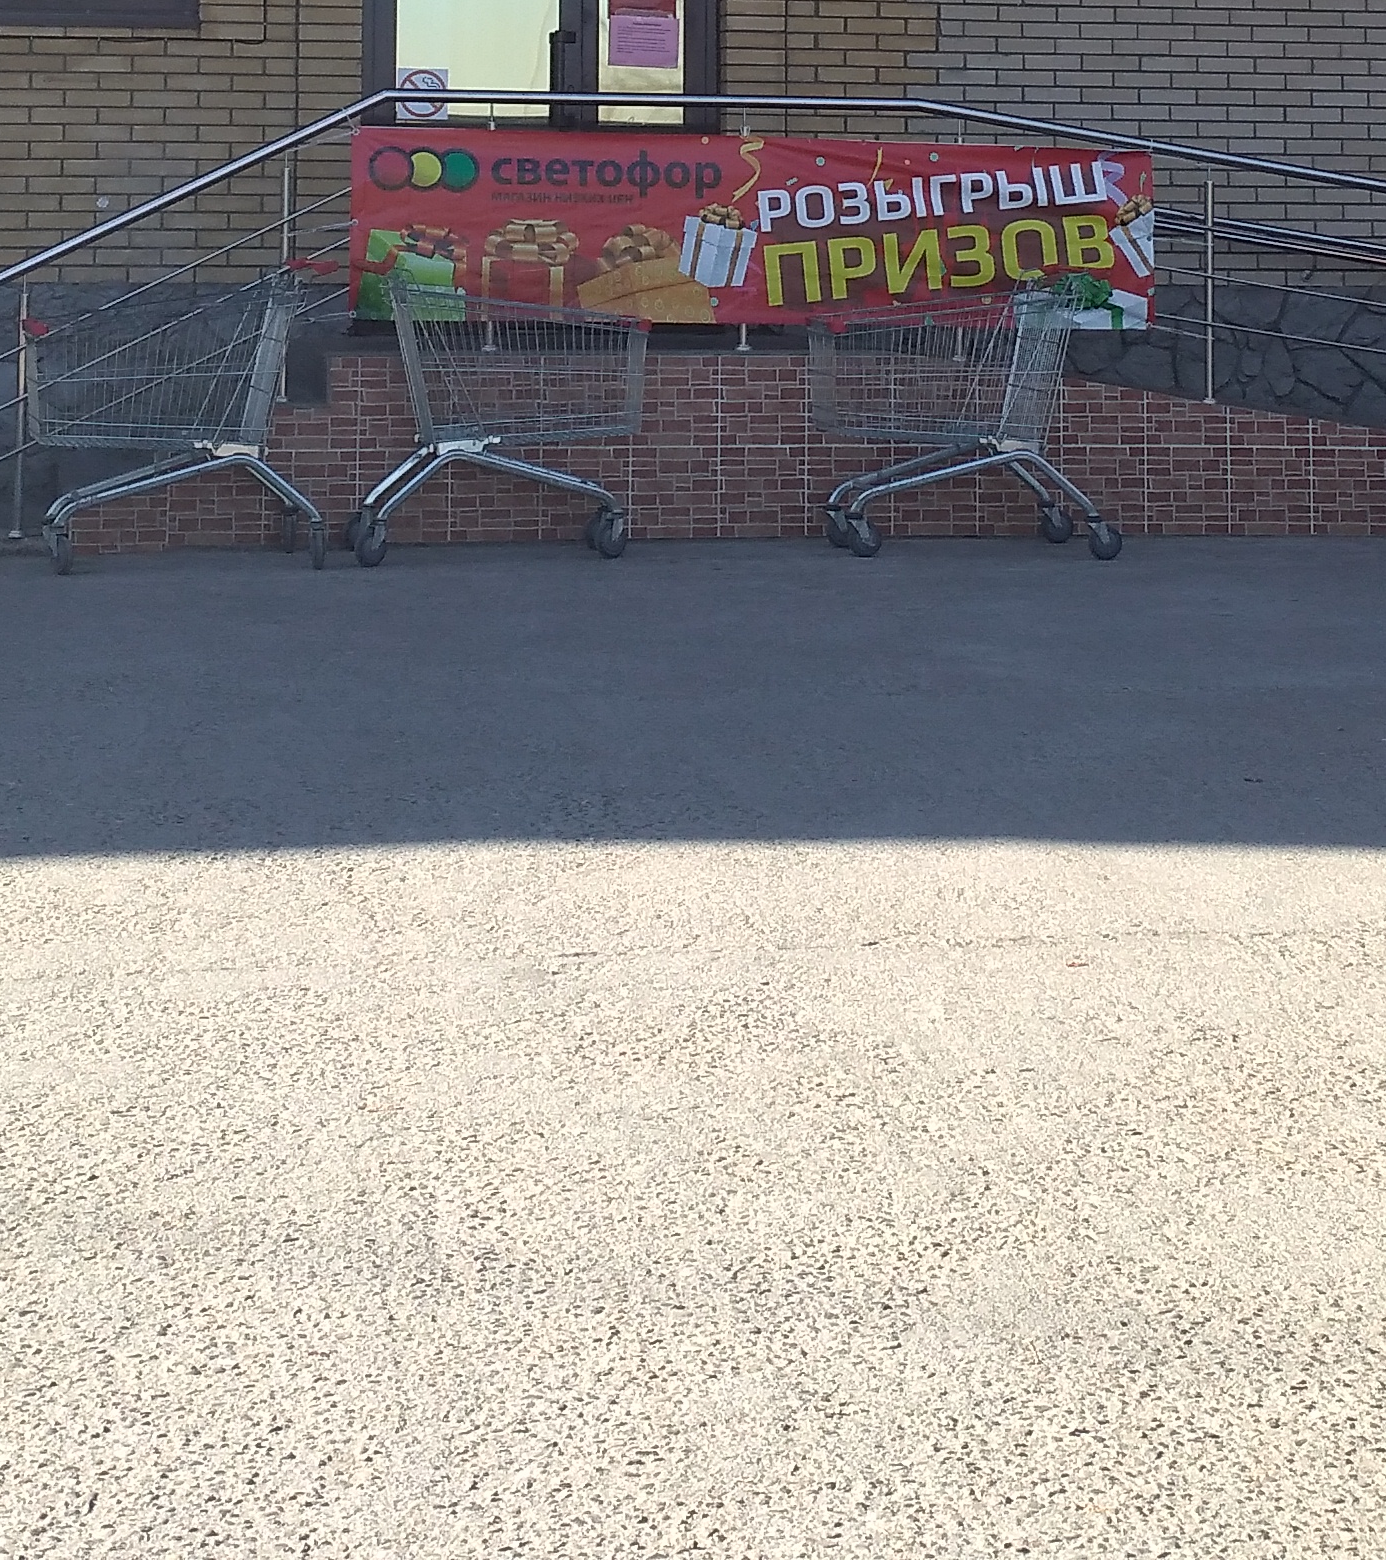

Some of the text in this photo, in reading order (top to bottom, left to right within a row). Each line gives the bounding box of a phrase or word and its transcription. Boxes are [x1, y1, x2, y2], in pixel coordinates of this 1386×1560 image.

[491, 149, 722, 199] светофор
[492, 192, 550, 204] МАГАЗИН
[757, 160, 1108, 232] РОЗЫГРЫШ
[763, 215, 1115, 306] ПРИЗОВ
